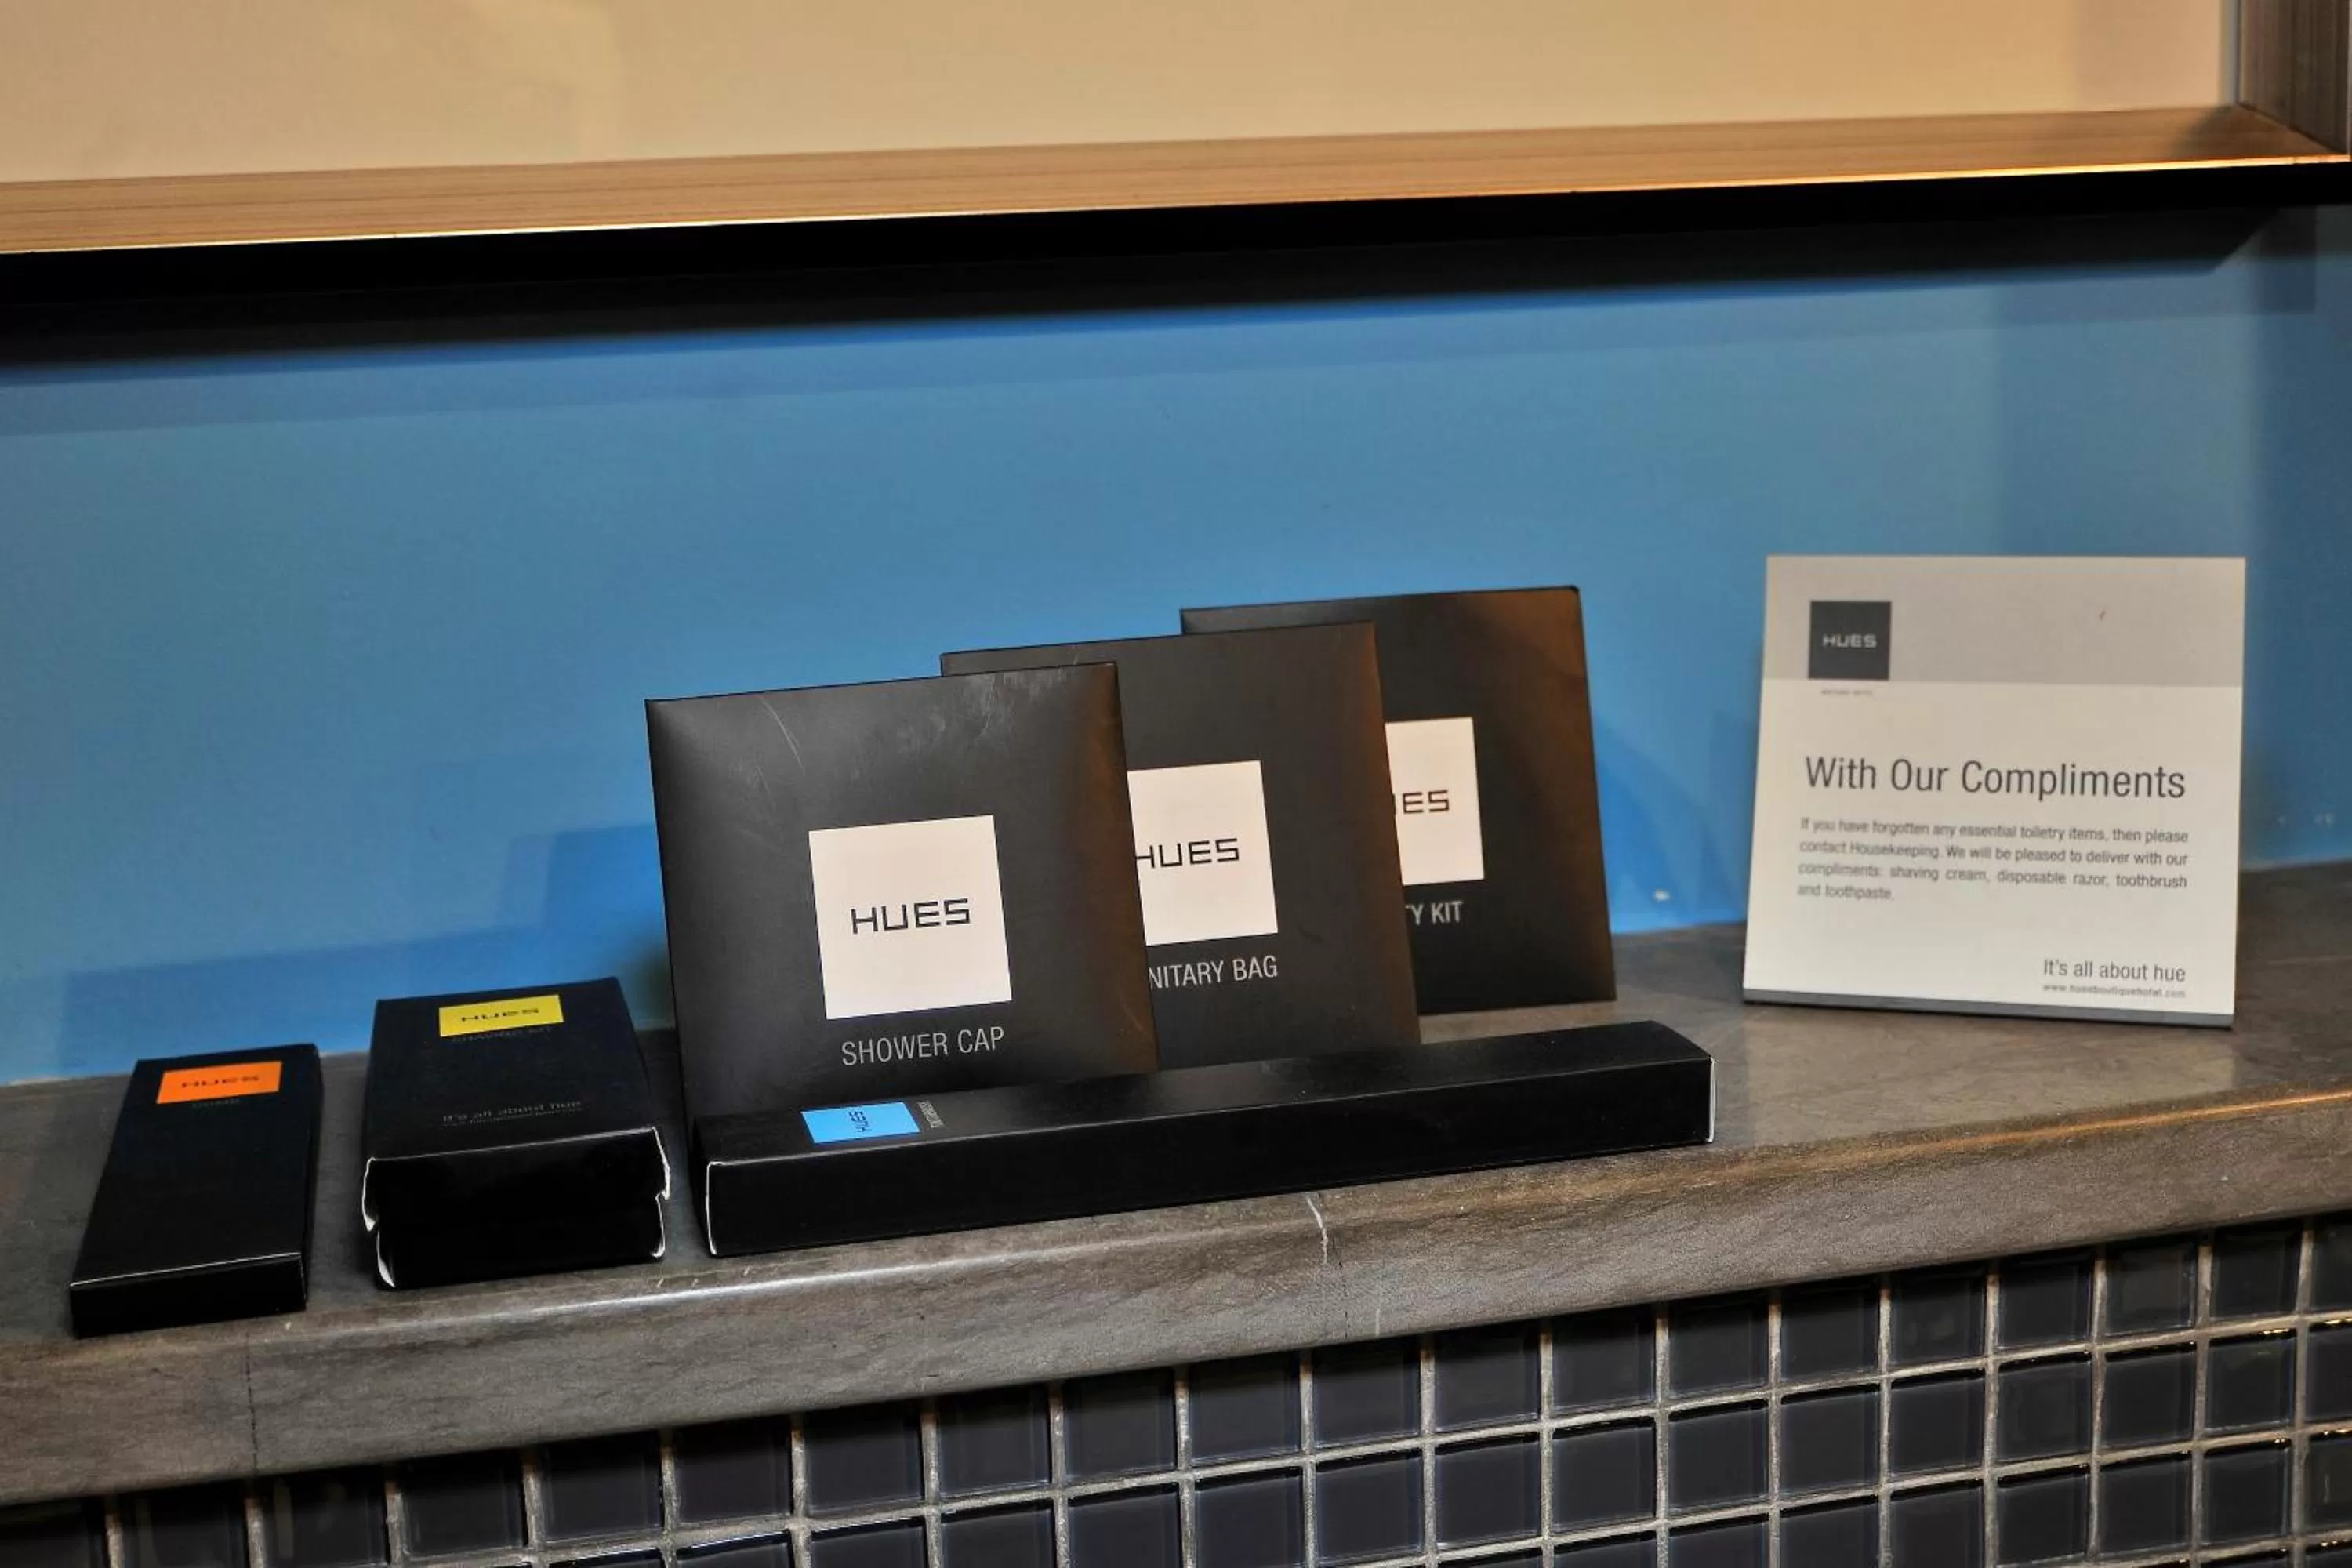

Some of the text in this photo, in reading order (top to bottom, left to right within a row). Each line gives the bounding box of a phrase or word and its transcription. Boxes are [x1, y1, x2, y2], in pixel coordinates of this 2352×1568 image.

[1821, 633, 1878, 648] HUES
[1806, 755, 2186, 803] With Our Compliments
[1393, 789, 1450, 815] ES
[1801, 817, 2189, 844] If you have forgotten any essential toiletry items, then please
[1135, 837, 1240, 869] HUES
[1799, 840, 1846, 854] contact
[1947, 845, 1966, 858] We
[1969, 846, 1992, 859] will
[1995, 848, 2011, 861] be
[2015, 848, 2066, 865] pleased
[2070, 849, 2083, 863] to
[2085, 850, 2129, 864] deliver
[2133, 851, 2161, 866] with
[2166, 853, 2187, 866] our
[1797, 883, 1820, 897] and
[1889, 866, 1939, 882] shaving
[1997, 869, 2067, 886] disposable
[2073, 873, 2111, 888] razor,
[2115, 873, 2187, 889] toothbrush
[851, 898, 970, 934] HUES
[1430, 901, 1465, 924] KIT
[1232, 955, 1278, 982] BAG
[2044, 958, 2186, 982] It's all about hue
[841, 1026, 1006, 1066] SHOWER CAP
